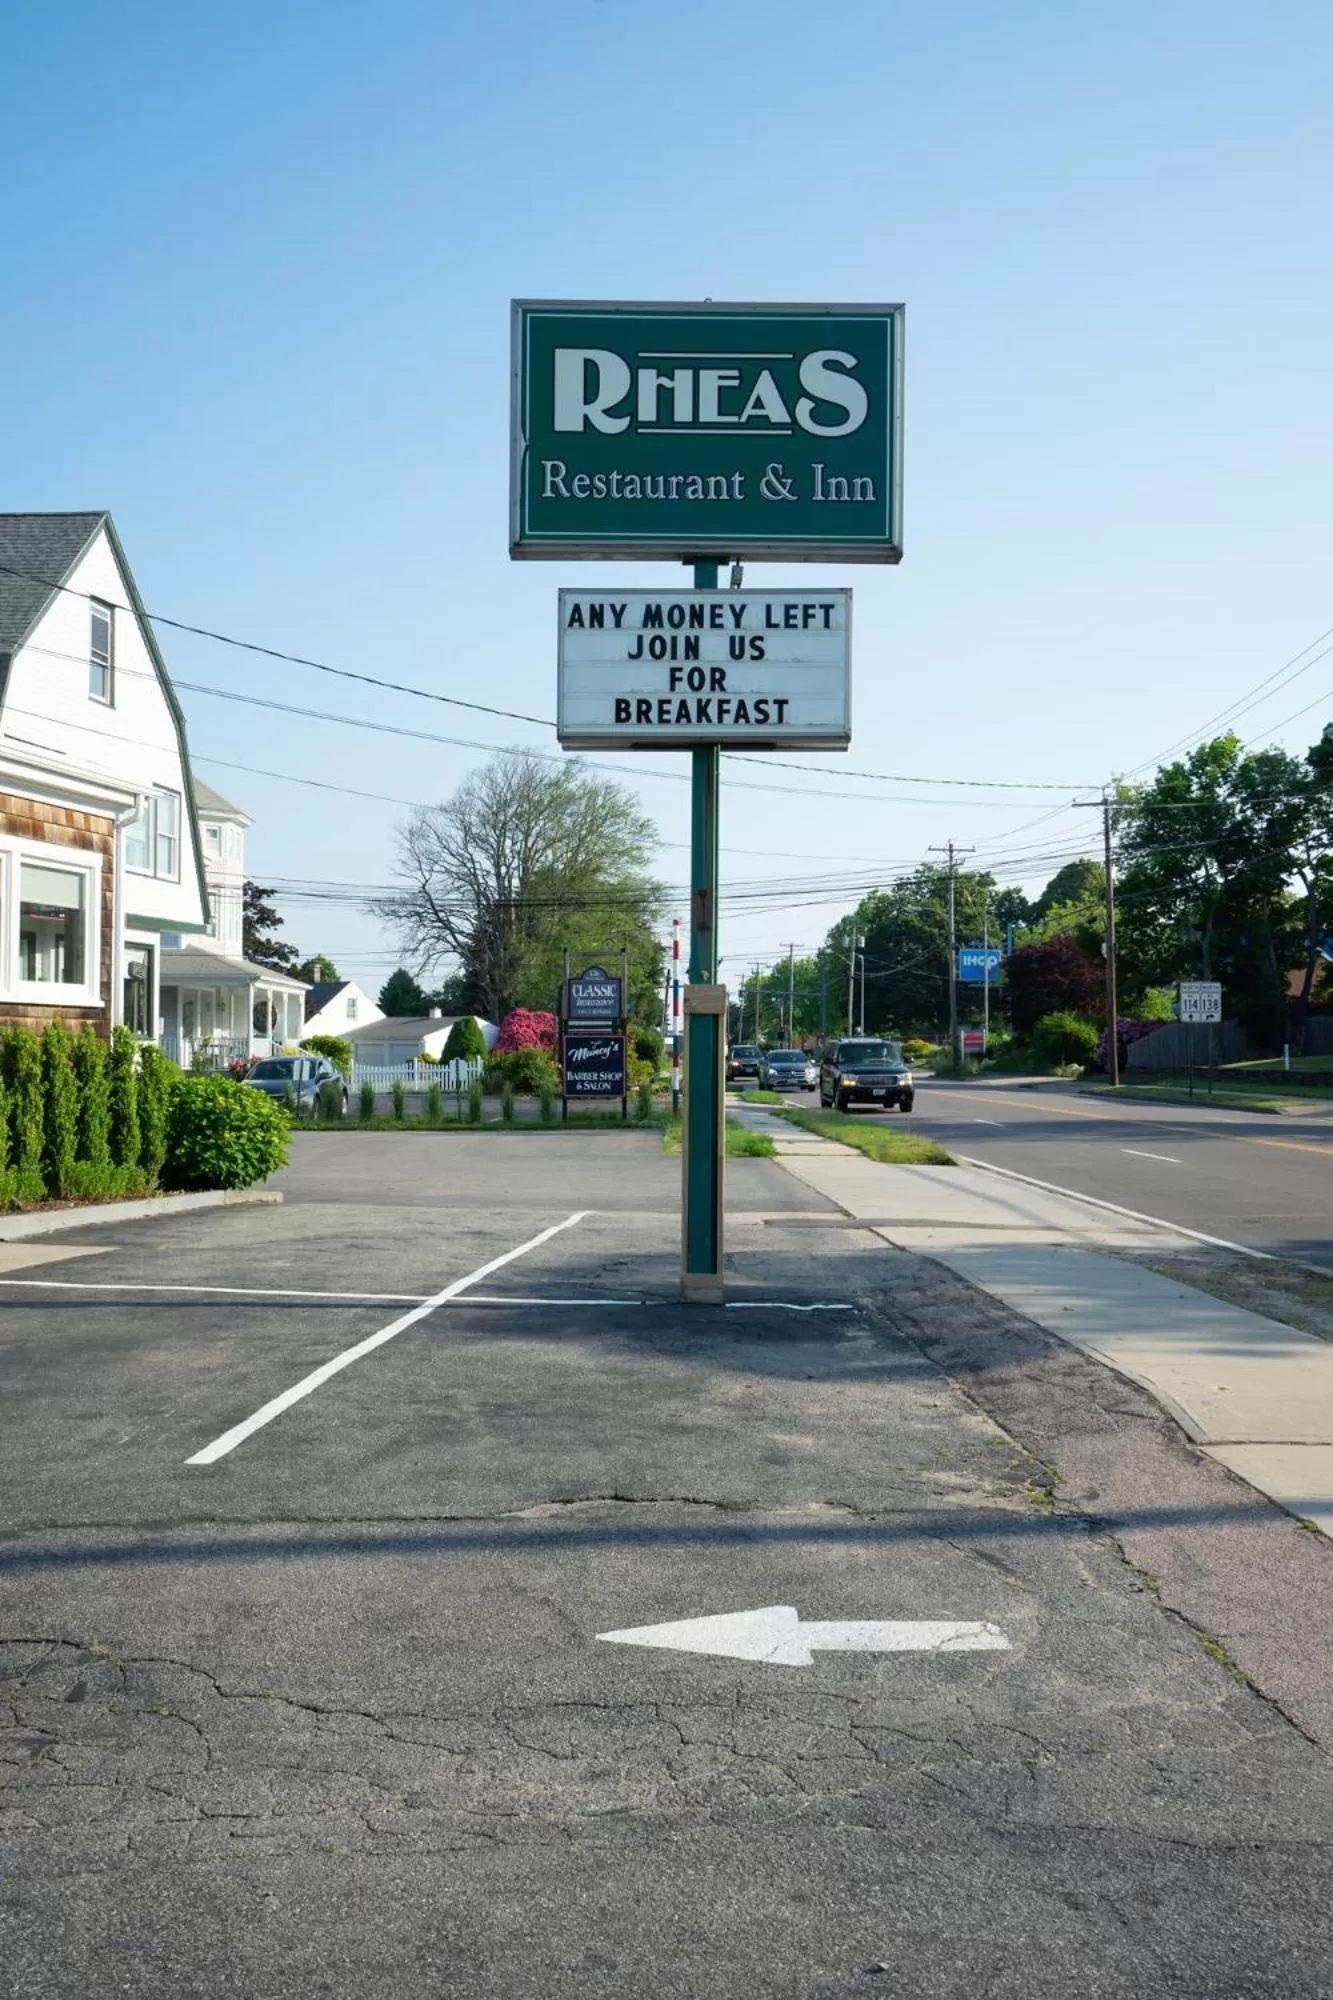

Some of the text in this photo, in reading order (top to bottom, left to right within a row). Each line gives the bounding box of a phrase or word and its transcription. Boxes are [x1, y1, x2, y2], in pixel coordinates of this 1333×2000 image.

[553, 348, 868, 437] RHEAS
[540, 460, 876, 501] Restaurant & Inn
[568, 603, 835, 629] ANY MONEY LEFT
[628, 635, 765, 660] JOIN US
[669, 667, 726, 692] FOR
[615, 698, 789, 724] BREAKFAST
[573, 984, 616, 996] CLASSIC
[1203, 999, 1219, 1010] 138
[567, 1071, 623, 1081] BARBER SHOP
[583, 1081, 612, 1090] SALON
